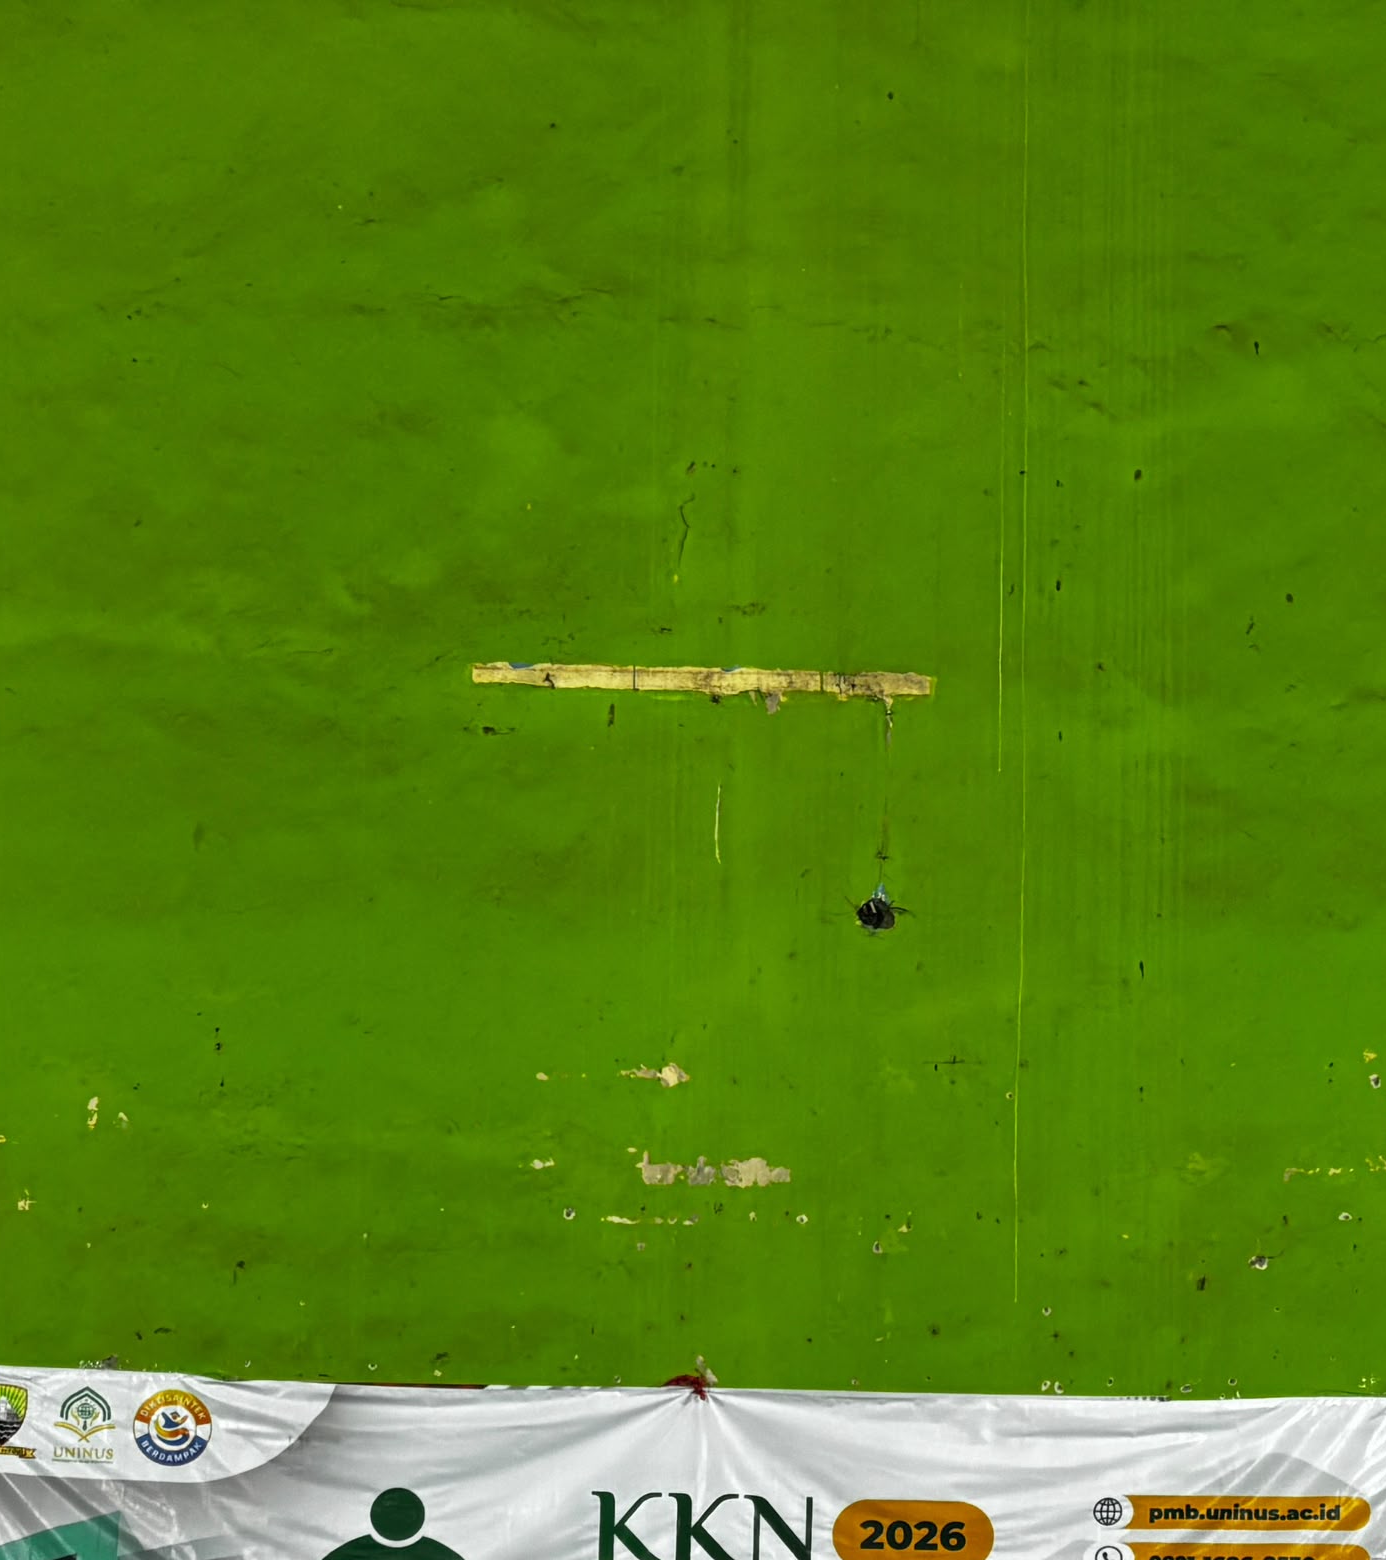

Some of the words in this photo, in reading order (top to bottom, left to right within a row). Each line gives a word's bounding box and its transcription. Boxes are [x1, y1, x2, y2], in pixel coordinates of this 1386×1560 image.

[54, 1446, 113, 1459] UNINUS
[141, 1440, 201, 1462] BERDAMPAK
[1149, 1503, 1341, 1523] pmb.uninus.ac.id
[859, 1519, 967, 1552] 2026
